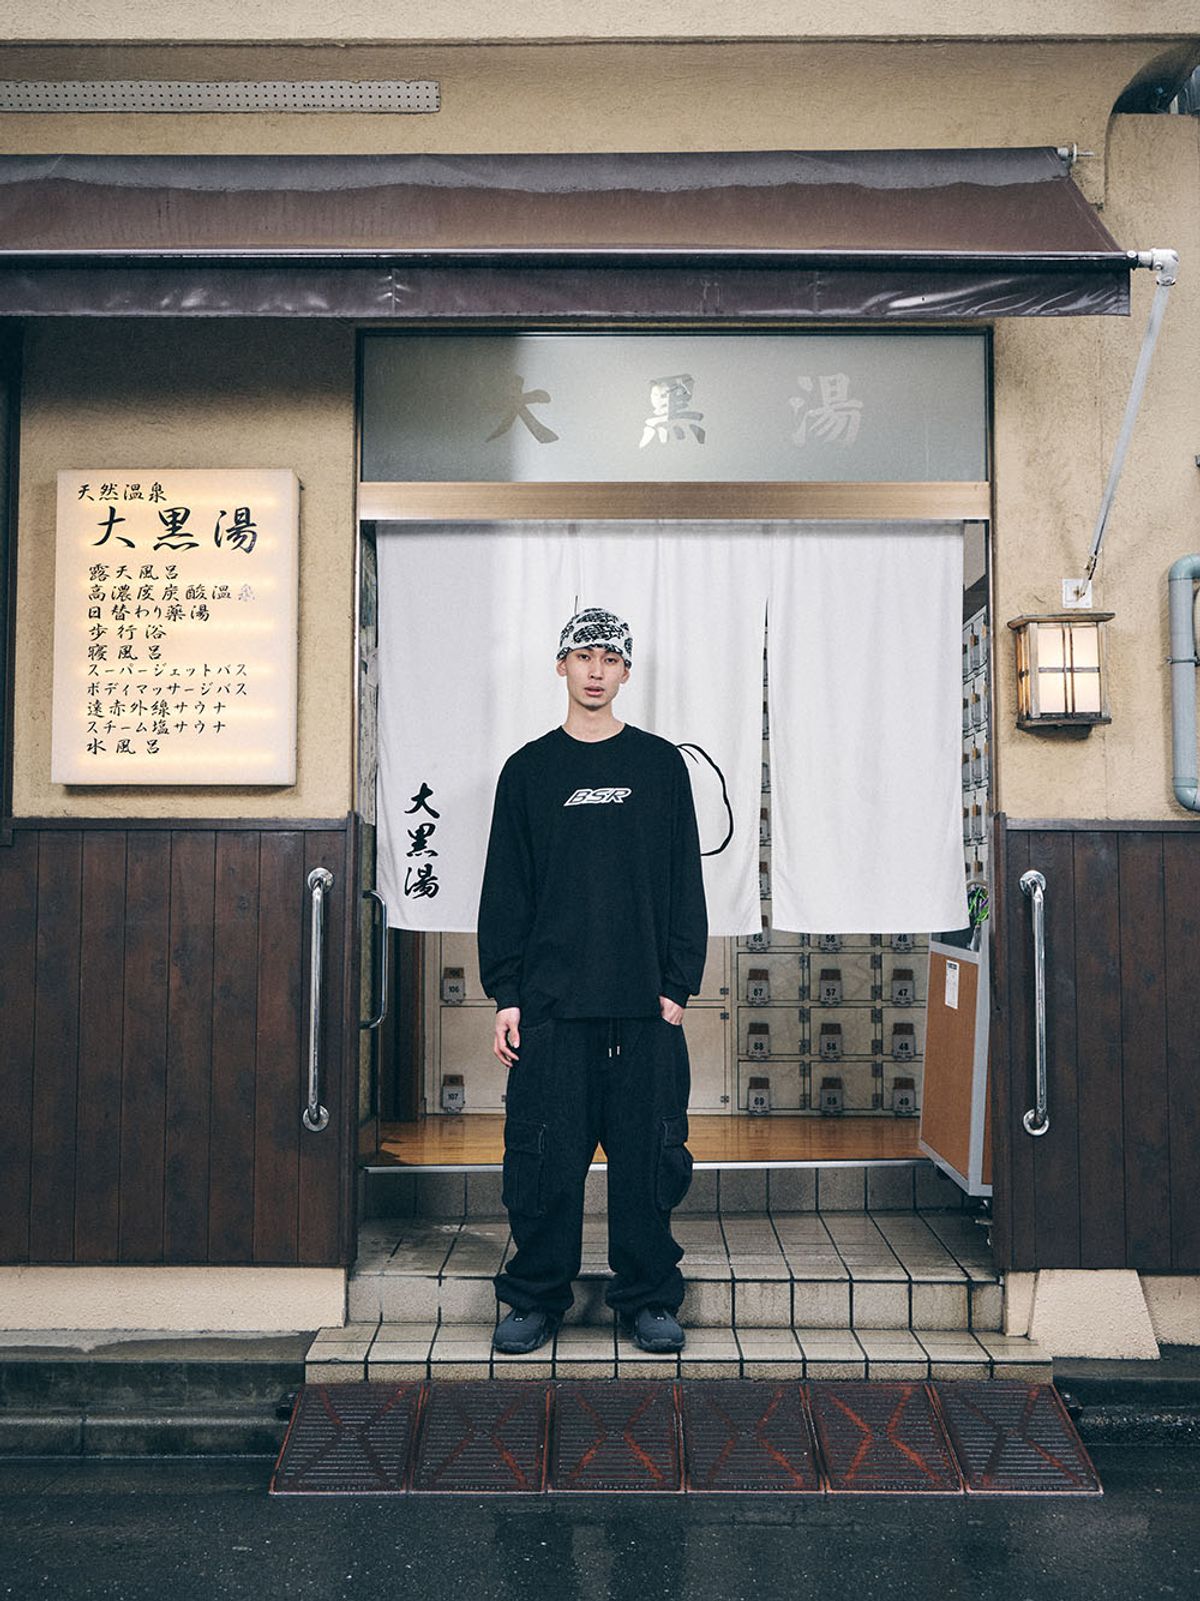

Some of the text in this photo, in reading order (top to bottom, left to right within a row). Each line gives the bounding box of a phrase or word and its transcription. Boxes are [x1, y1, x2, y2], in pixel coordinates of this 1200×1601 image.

[485, 372, 865, 449] 大黒湯
[77, 481, 167, 504] 天然温泉
[92, 505, 258, 555] 大黒湯
[88, 562, 179, 583] 露天風呂
[87, 603, 211, 622] 日替わり薬湯
[88, 623, 167, 642] 歩行浴
[87, 643, 162, 662] 寝風呂
[87, 662, 248, 678] スーパージェットバス
[86, 681, 248, 697] ボディマッサージバス
[86, 699, 227, 719] 遠赤外線サウナ
[86, 719, 227, 736] スチーム塩サウナ
[86, 737, 160, 756] 水風呂
[404, 782, 441, 899] 大黒湯
[825, 988, 837, 996] 57
[898, 988, 908, 996] 47
